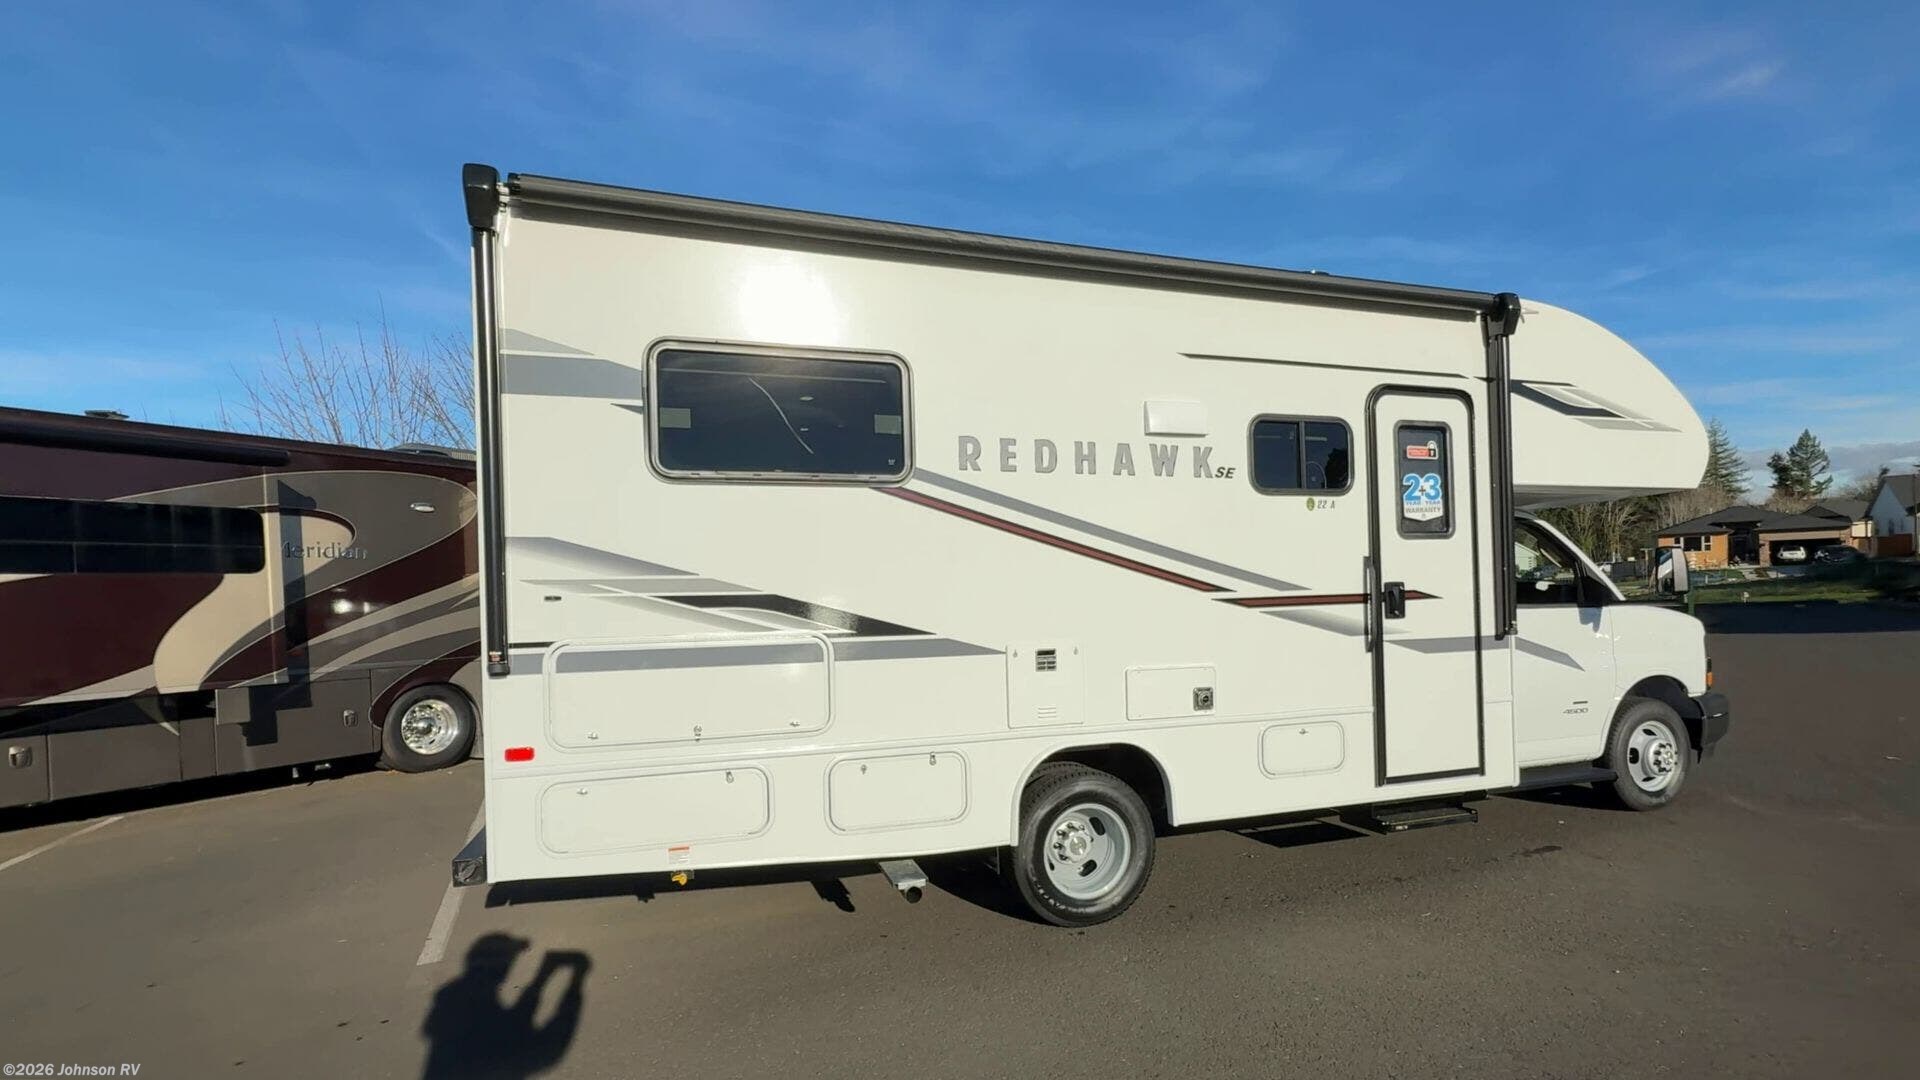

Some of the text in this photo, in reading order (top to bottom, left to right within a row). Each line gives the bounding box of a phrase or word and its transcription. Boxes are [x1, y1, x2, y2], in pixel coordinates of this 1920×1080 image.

[957, 435, 1236, 479] REDHAWK SE
[1405, 506, 1442, 514] WARRANTY
